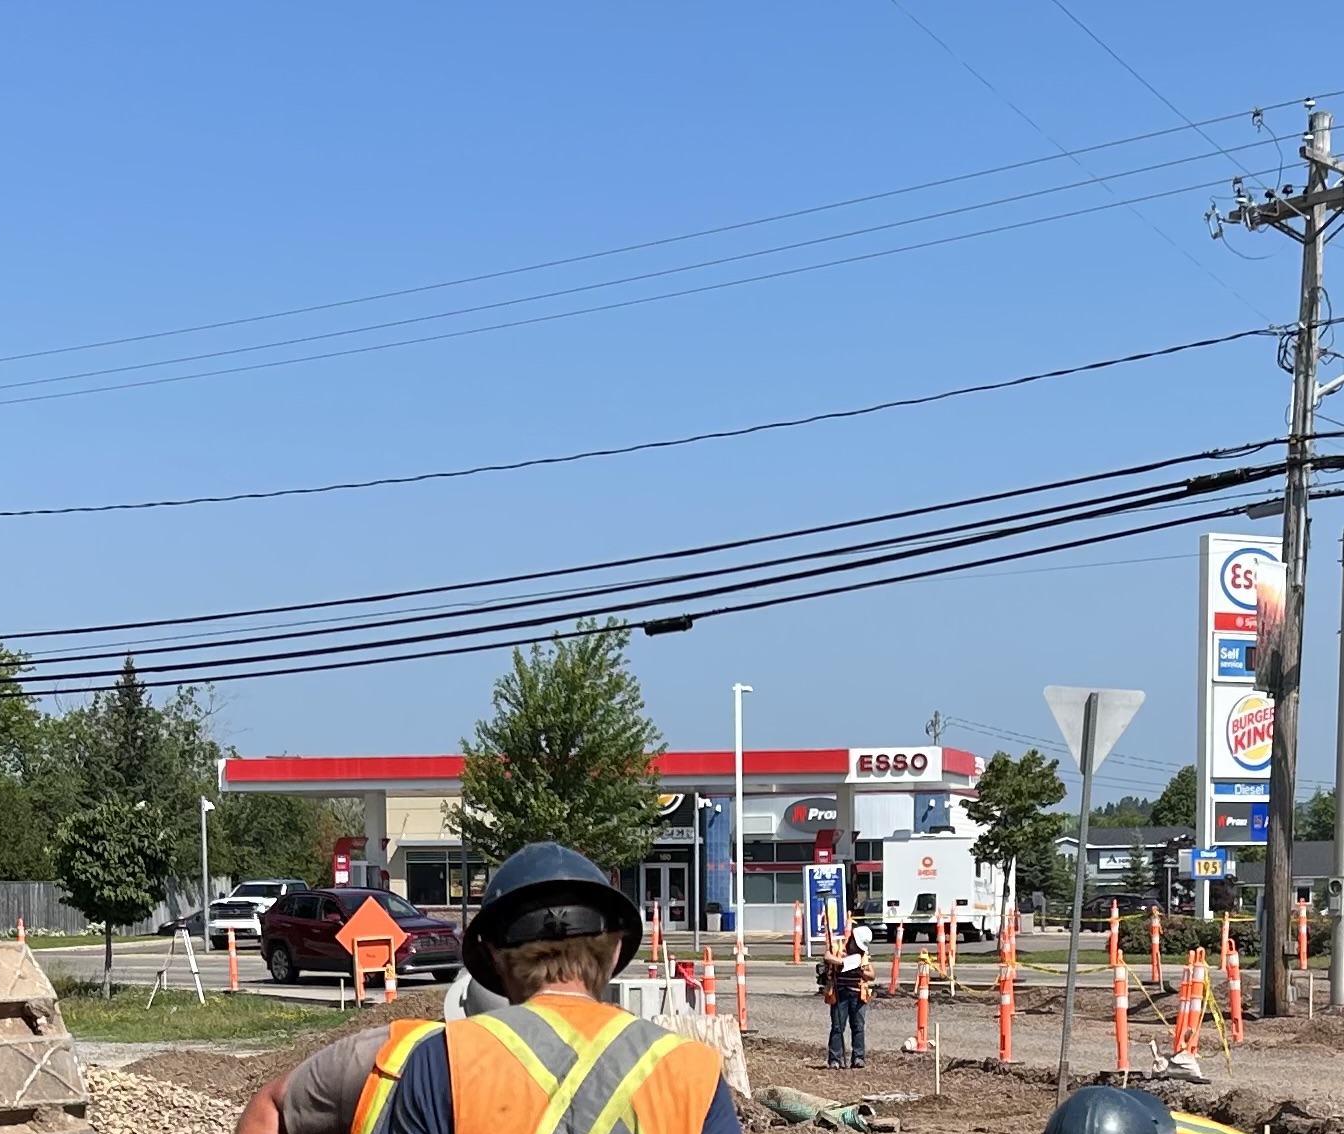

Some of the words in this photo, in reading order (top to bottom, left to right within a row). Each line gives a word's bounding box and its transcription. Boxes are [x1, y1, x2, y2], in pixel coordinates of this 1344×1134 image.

[1220, 647, 1240, 660] Self
[858, 753, 928, 772] ESSO
[1234, 783, 1265, 795] Diesel
